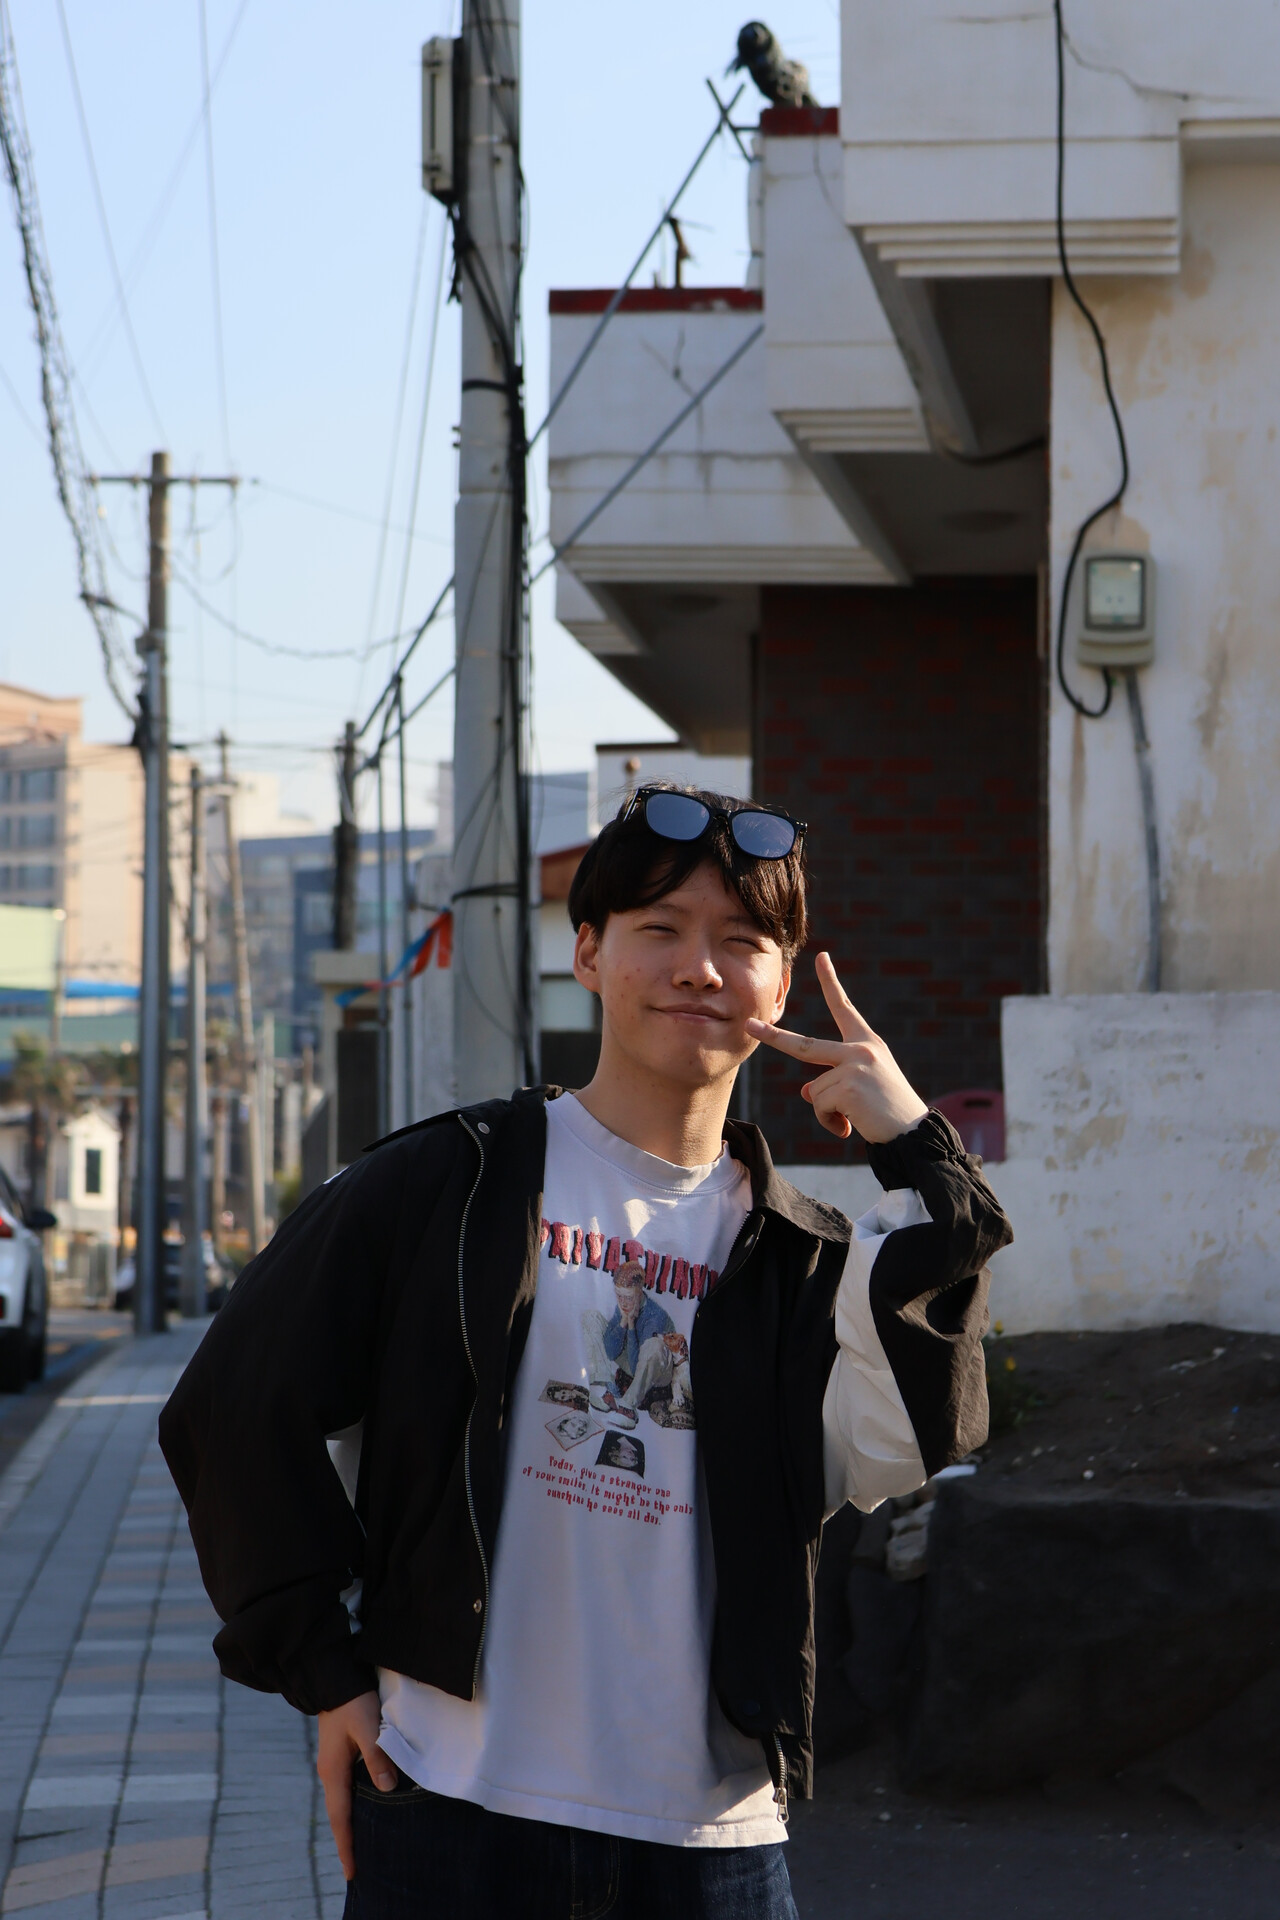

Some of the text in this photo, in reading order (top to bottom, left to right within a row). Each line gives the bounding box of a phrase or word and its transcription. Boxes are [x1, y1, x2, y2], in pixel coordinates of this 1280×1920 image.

[522, 1465, 533, 1477] of
[536, 1470, 556, 1482] your
[591, 1483, 600, 1496] It
[604, 1490, 636, 1507] might
[639, 1496, 650, 1507] be
[654, 1499, 670, 1515] the
[673, 1502, 694, 1515] only
[549, 1455, 671, 1498] Today, give a stranger one
[546, 1488, 584, 1505] sunshine
[586, 1497, 598, 1512] he
[602, 1504, 624, 1517] sees
[627, 1508, 641, 1521] all
